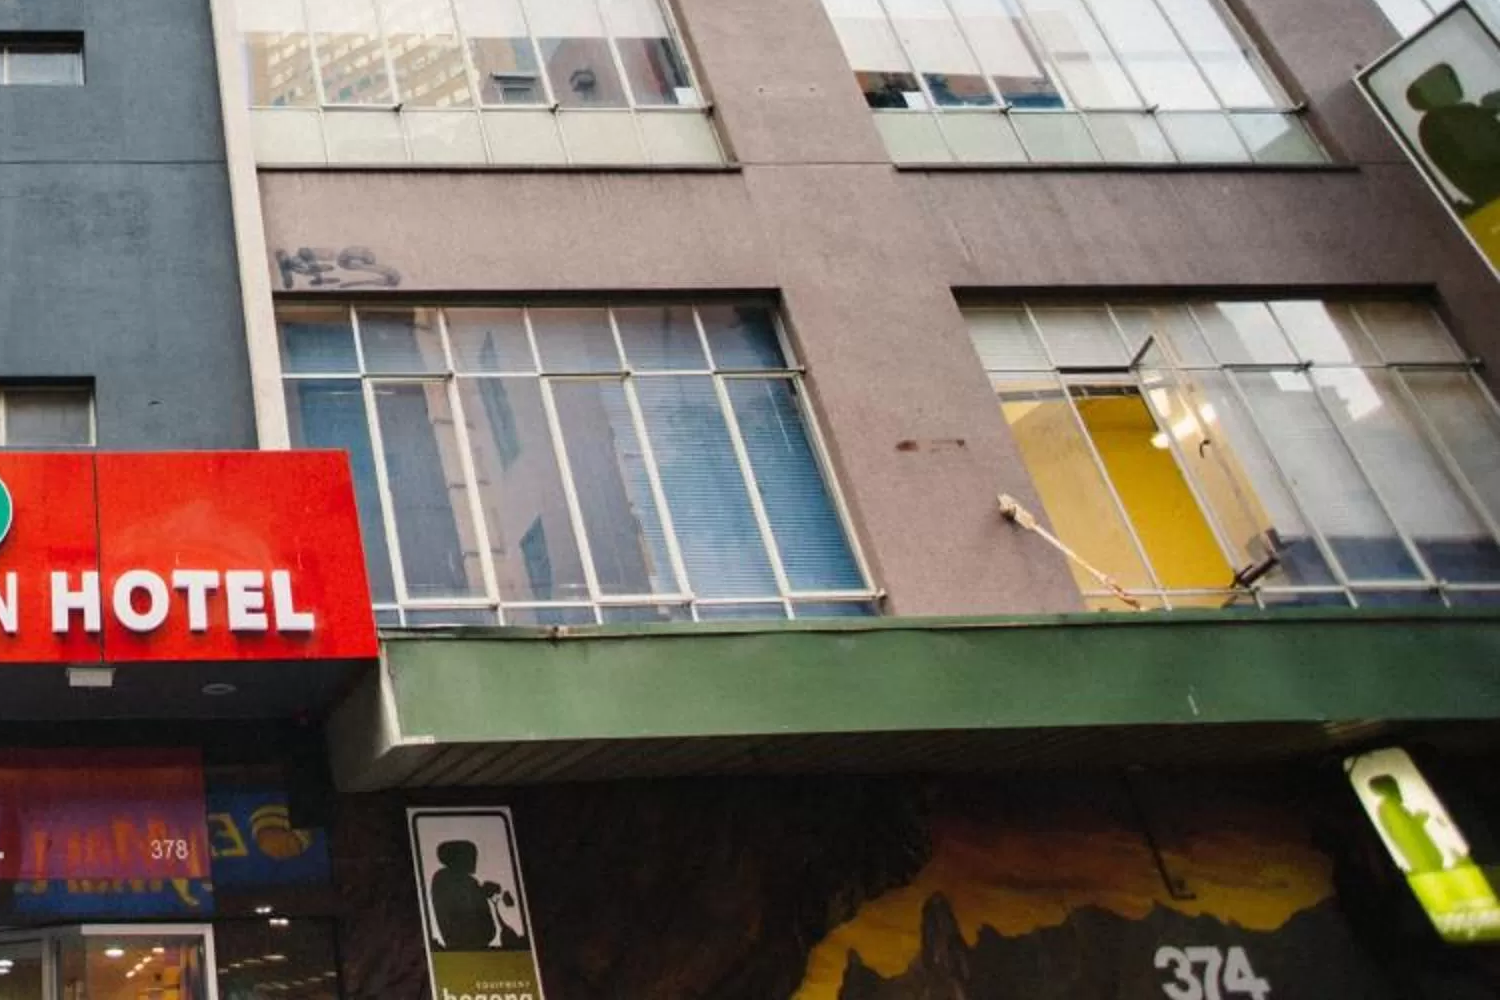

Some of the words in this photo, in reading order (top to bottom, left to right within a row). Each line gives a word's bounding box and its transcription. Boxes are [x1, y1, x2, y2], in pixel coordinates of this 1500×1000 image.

[51, 569, 315, 632] HOTEL
[150, 839, 189, 860] 378
[1153, 945, 1271, 1000] 374
